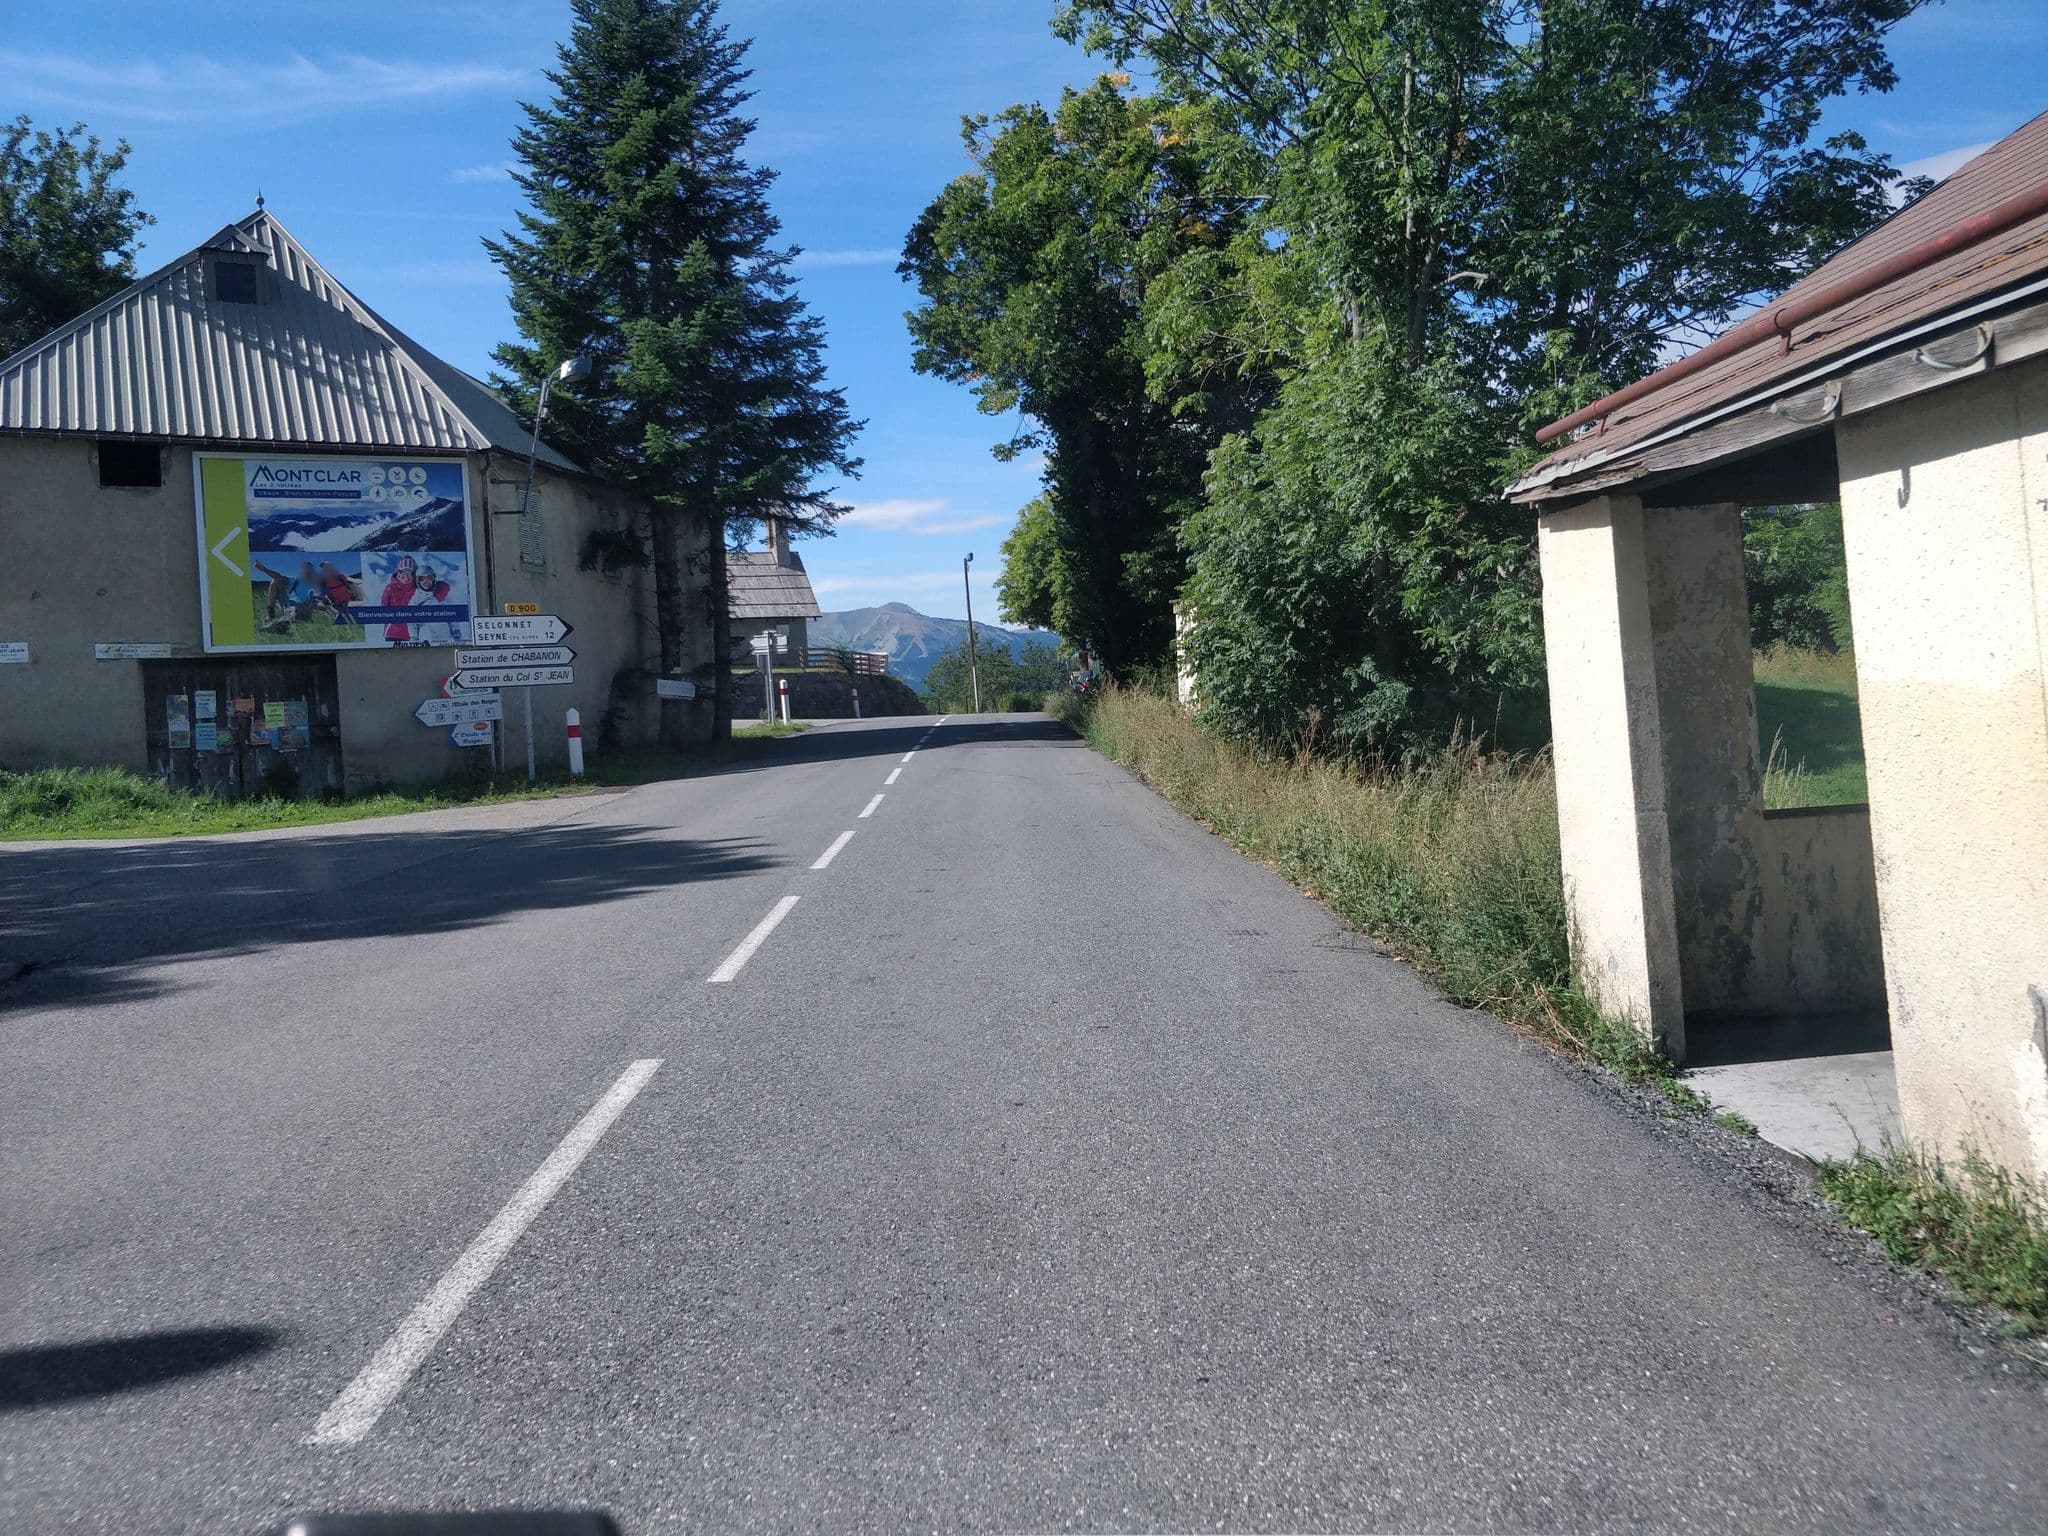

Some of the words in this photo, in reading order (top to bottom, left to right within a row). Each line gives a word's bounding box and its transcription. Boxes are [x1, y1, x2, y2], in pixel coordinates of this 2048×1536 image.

[250, 465, 361, 486] MONTCLAR
[509, 604, 516, 613] D
[518, 604, 536, 613] 900
[477, 620, 532, 630] SELONNET
[548, 620, 554, 628] 7
[478, 632, 507, 641] SEYNE
[545, 631, 555, 639] 12
[461, 654, 494, 664] Station
[497, 653, 508, 662] de
[511, 651, 562, 662] CHABANON
[469, 674, 500, 684] Station
[503, 672, 513, 681] du
[516, 671, 530, 681] Col
[547, 670, 570, 680] JEAN
